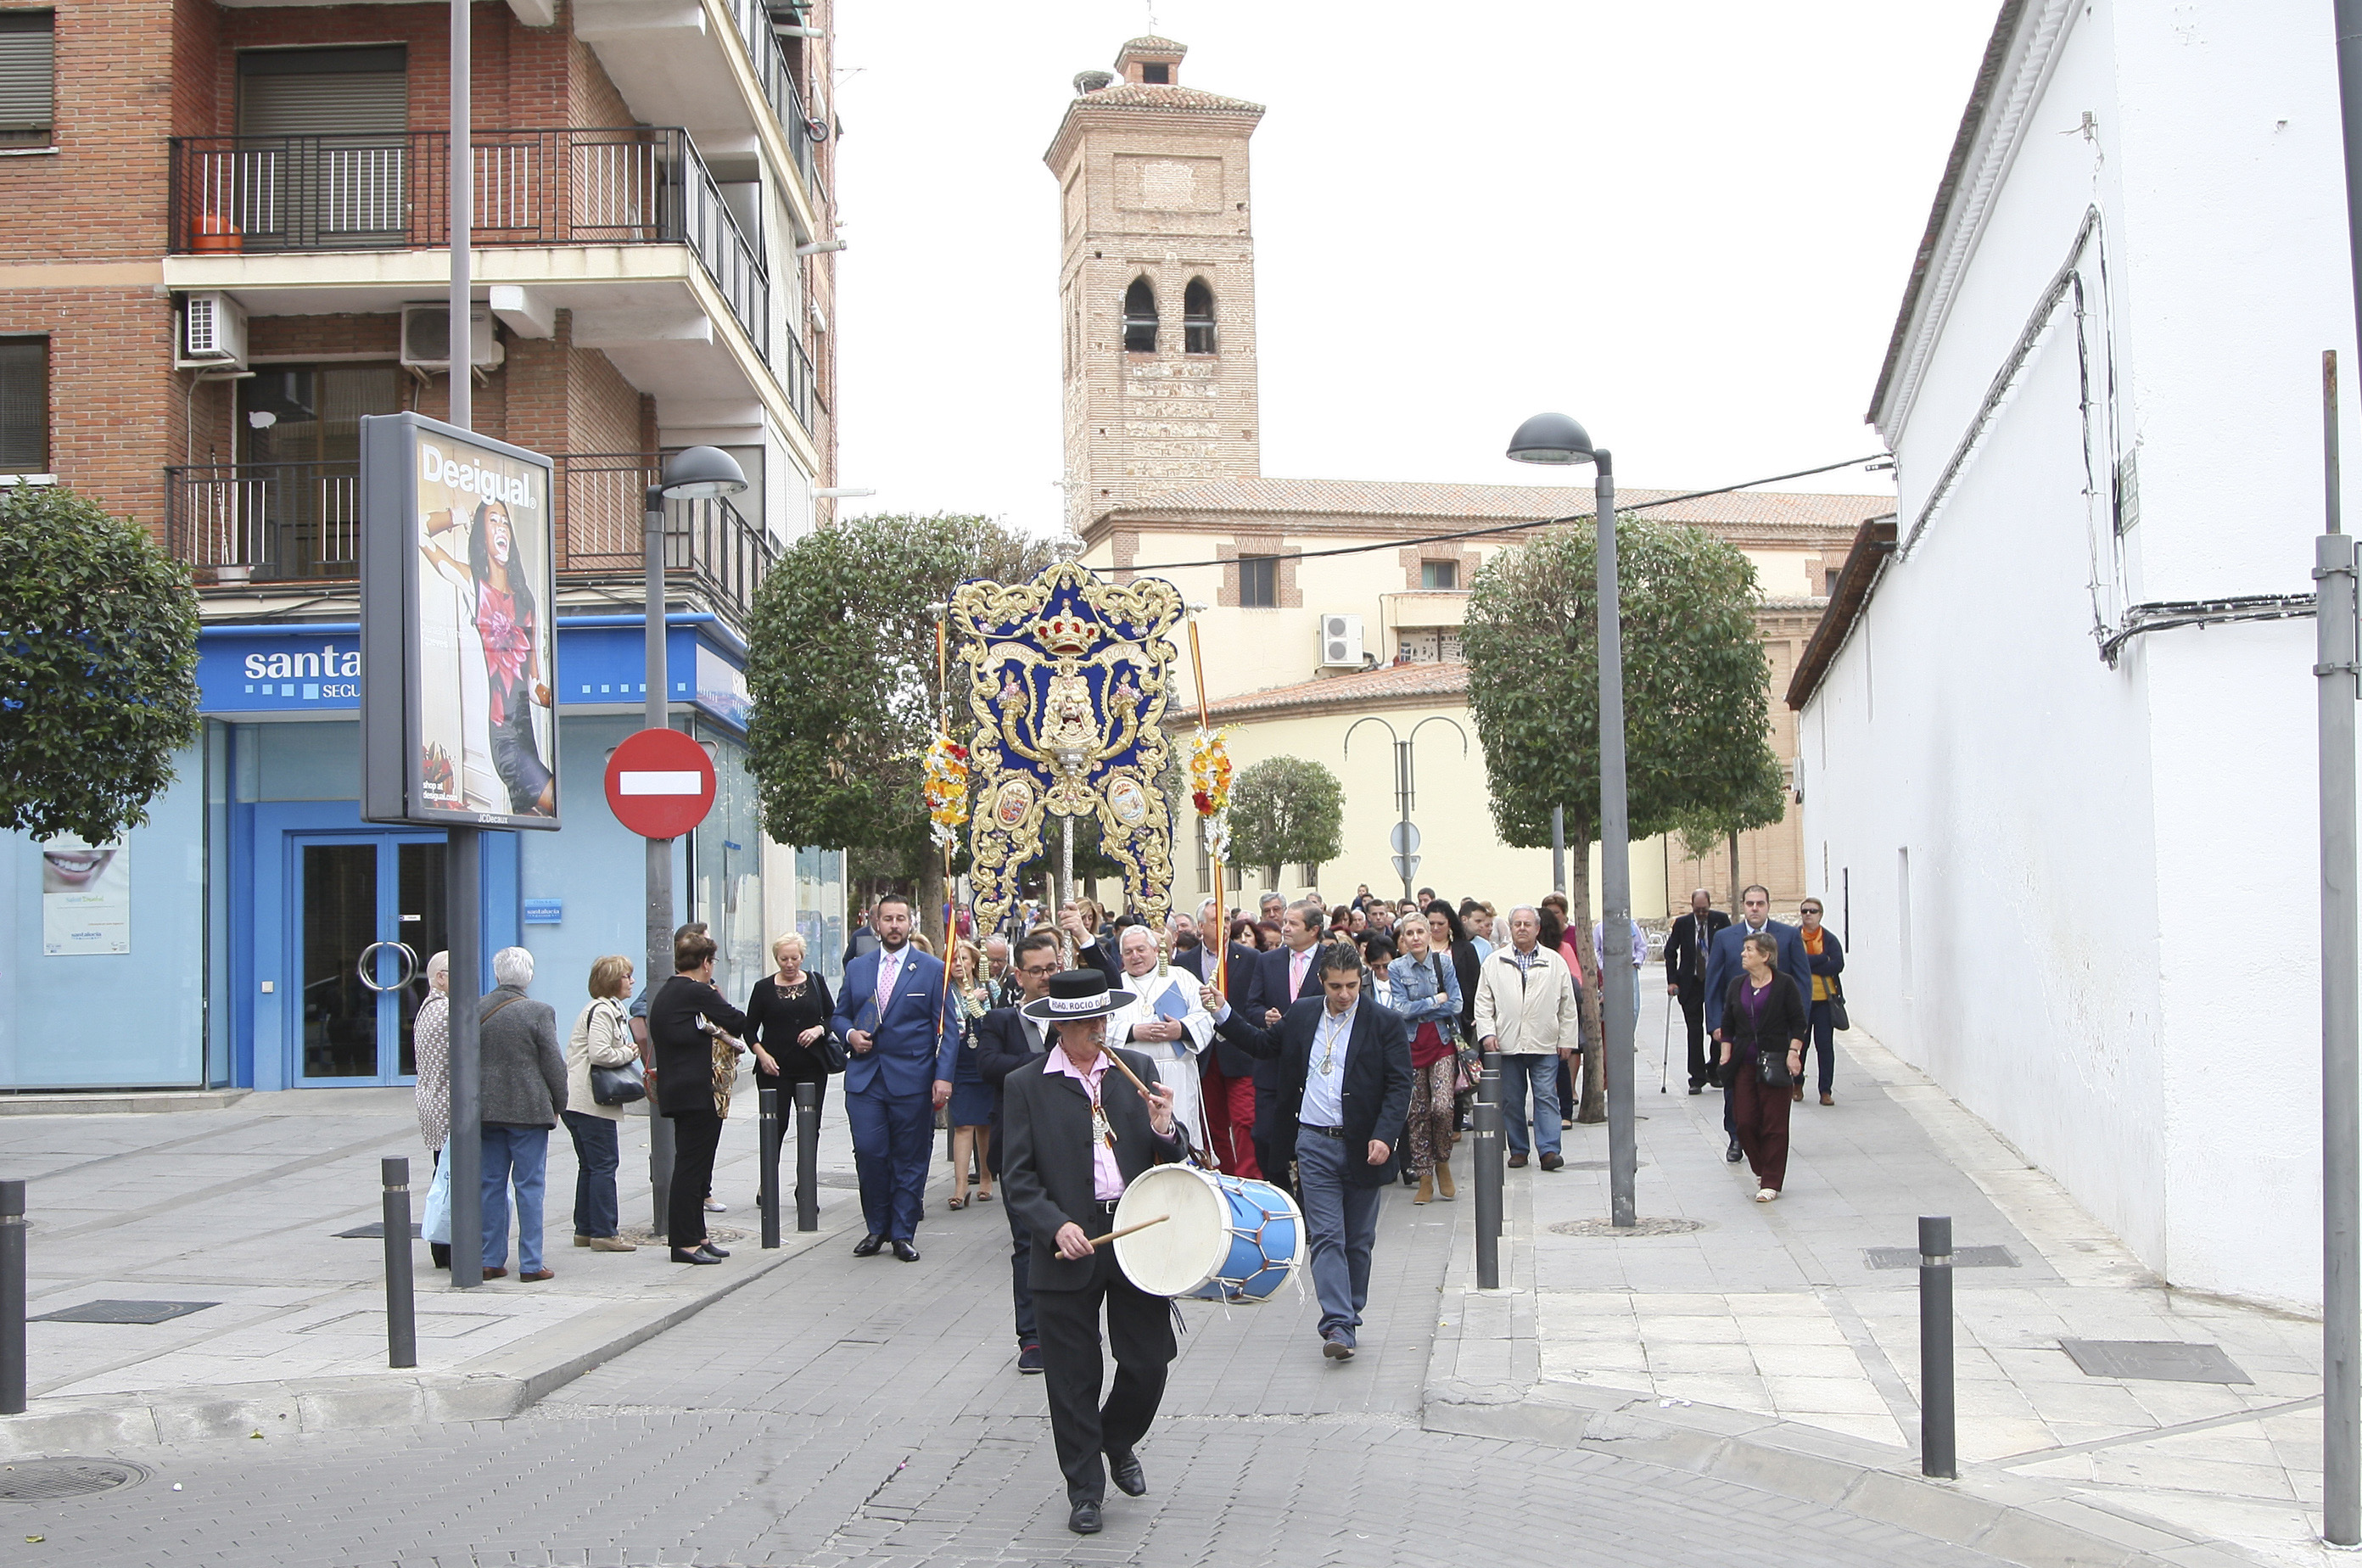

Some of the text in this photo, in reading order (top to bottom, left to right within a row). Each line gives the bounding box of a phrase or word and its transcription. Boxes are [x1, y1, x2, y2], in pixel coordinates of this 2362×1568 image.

[244, 644, 361, 680] santa
[423, 780, 444, 792] shop at
[423, 790, 458, 802] desigual.com
[478, 814, 508, 824] JCDecaux
